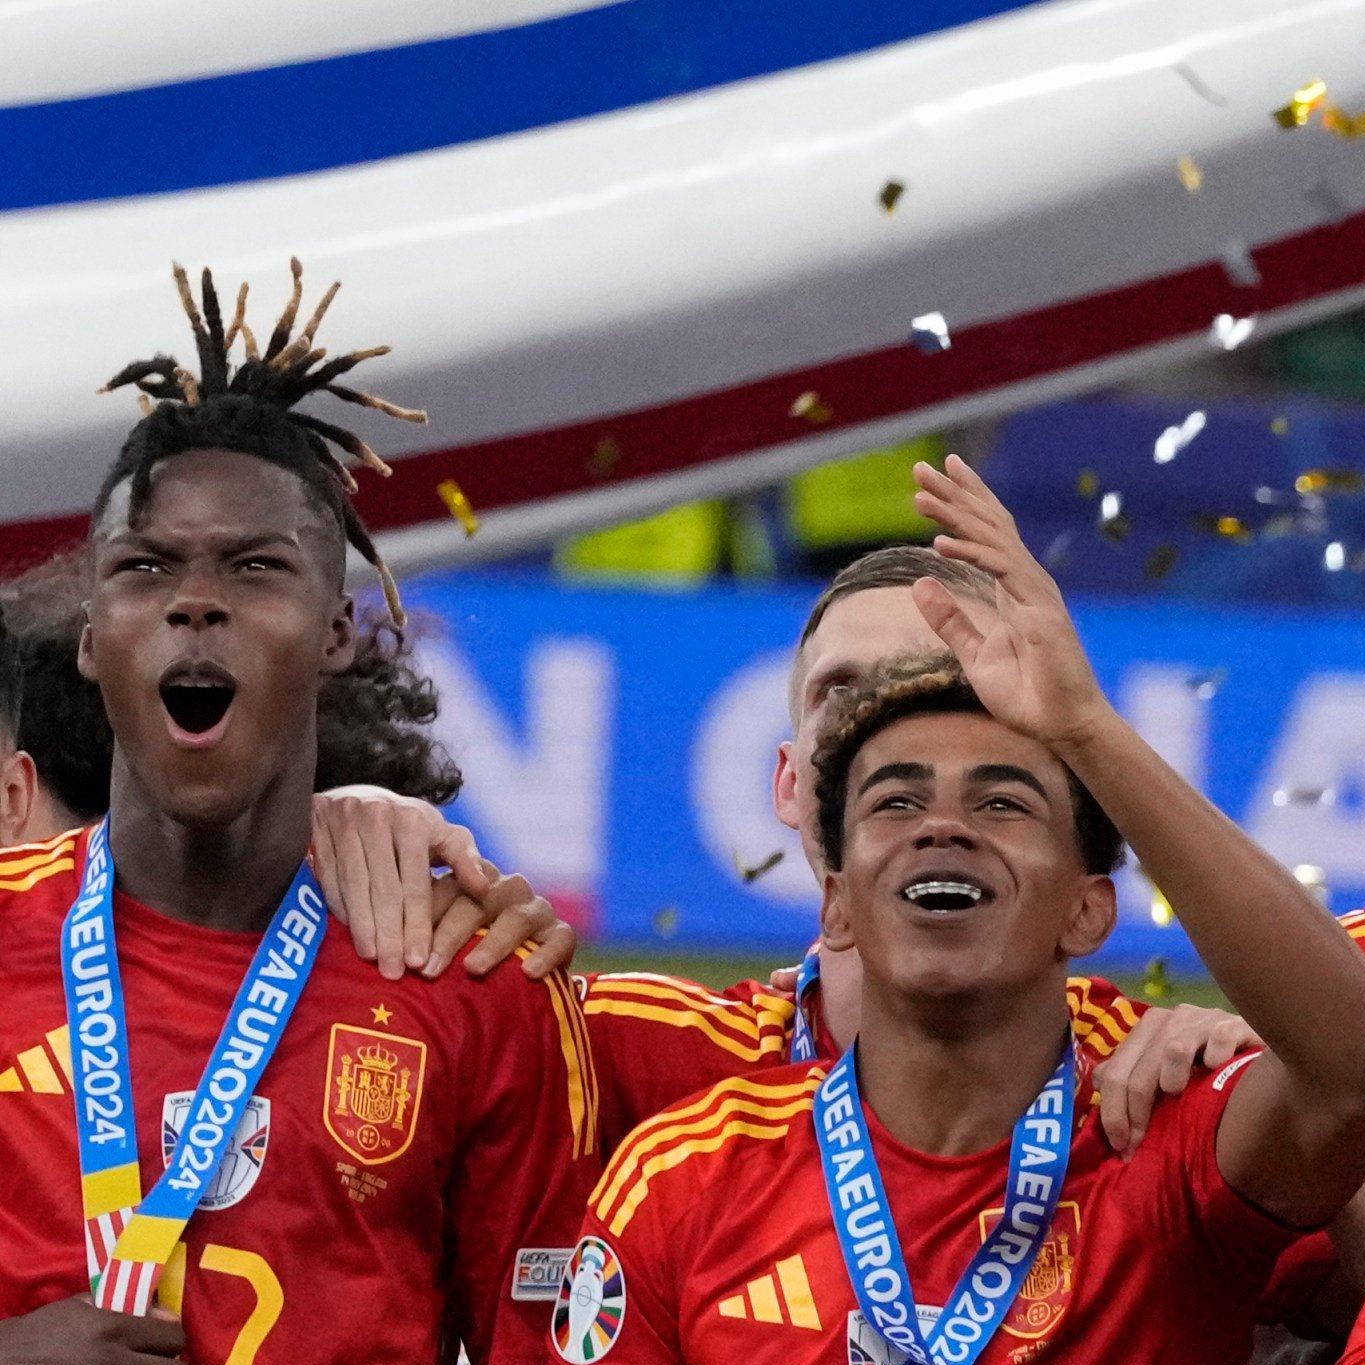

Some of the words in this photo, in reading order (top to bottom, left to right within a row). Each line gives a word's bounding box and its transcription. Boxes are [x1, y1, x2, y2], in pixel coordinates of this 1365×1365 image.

[259, 883, 324, 982] UEFA
[69, 915, 125, 1147] EURO2024
[167, 984, 289, 1191] EURO2024
[820, 1064, 865, 1183] UEFA
